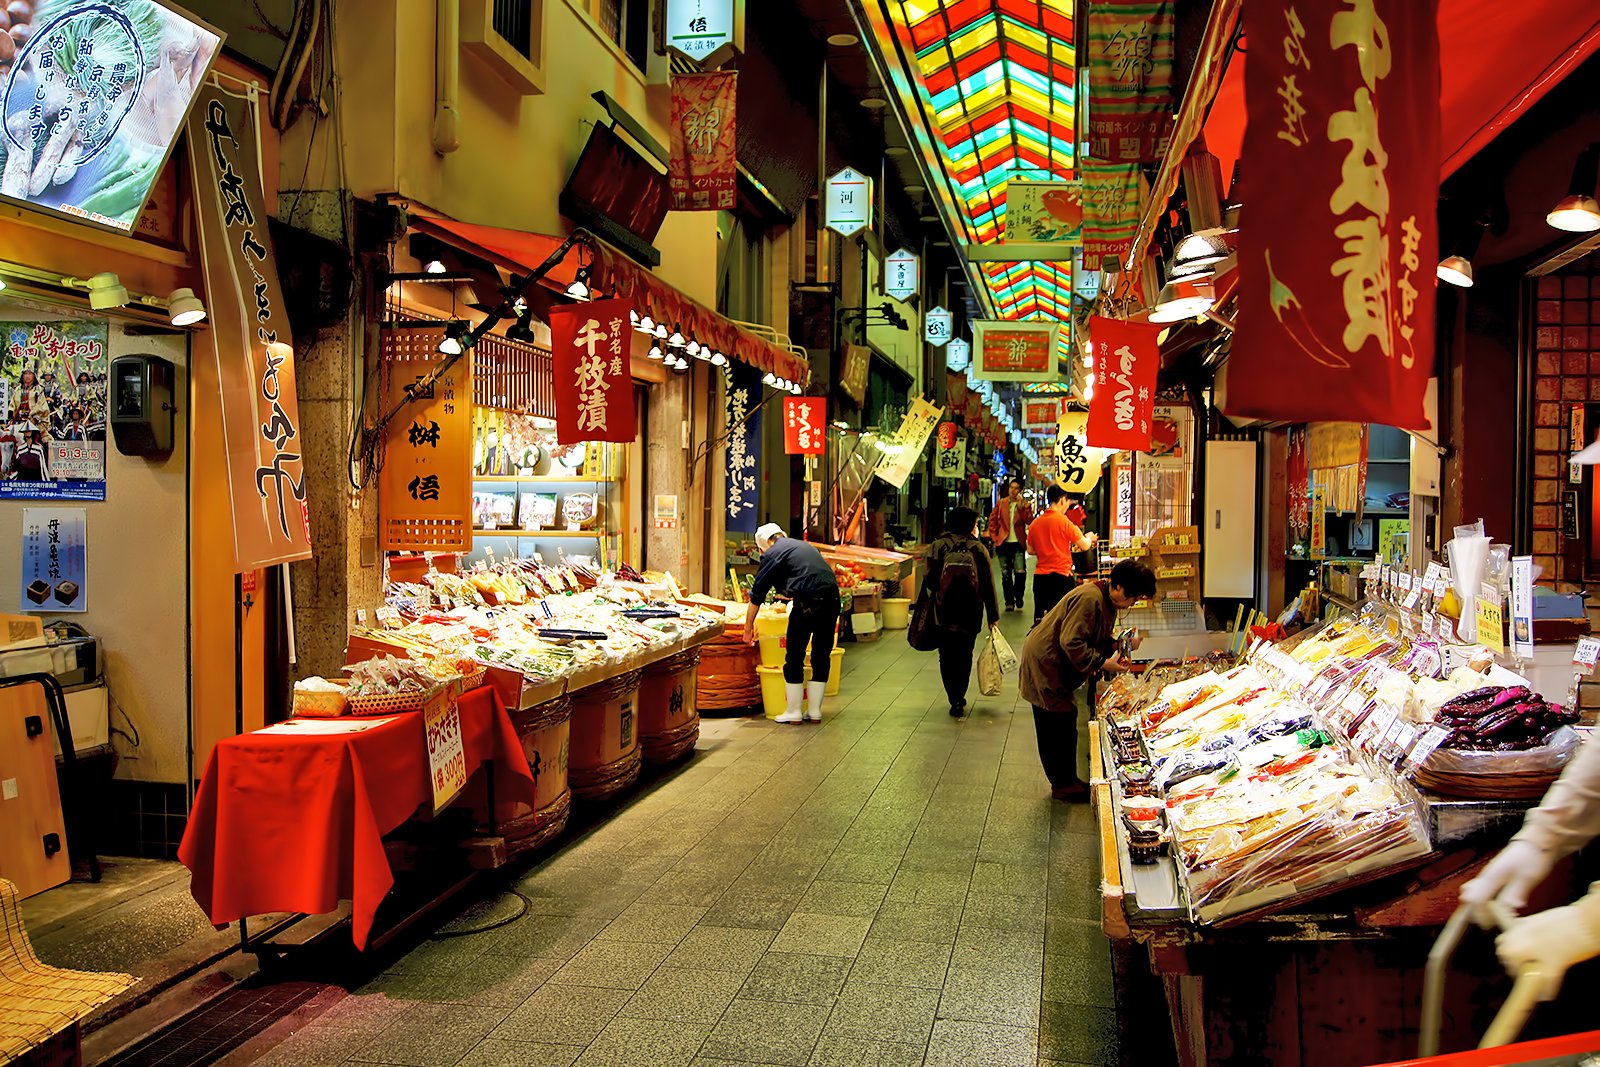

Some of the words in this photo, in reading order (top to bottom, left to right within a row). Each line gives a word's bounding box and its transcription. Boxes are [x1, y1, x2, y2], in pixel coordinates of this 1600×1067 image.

[683, 39, 716, 51] 京漬物
[840, 190, 853, 213] 河一
[10, 344, 39, 358] 亀岡
[30, 324, 102, 361] 光秀まつり
[607, 317, 623, 377] 京名産
[573, 318, 610, 433] 千枚漬
[1061, 435, 1087, 485] 魚力
